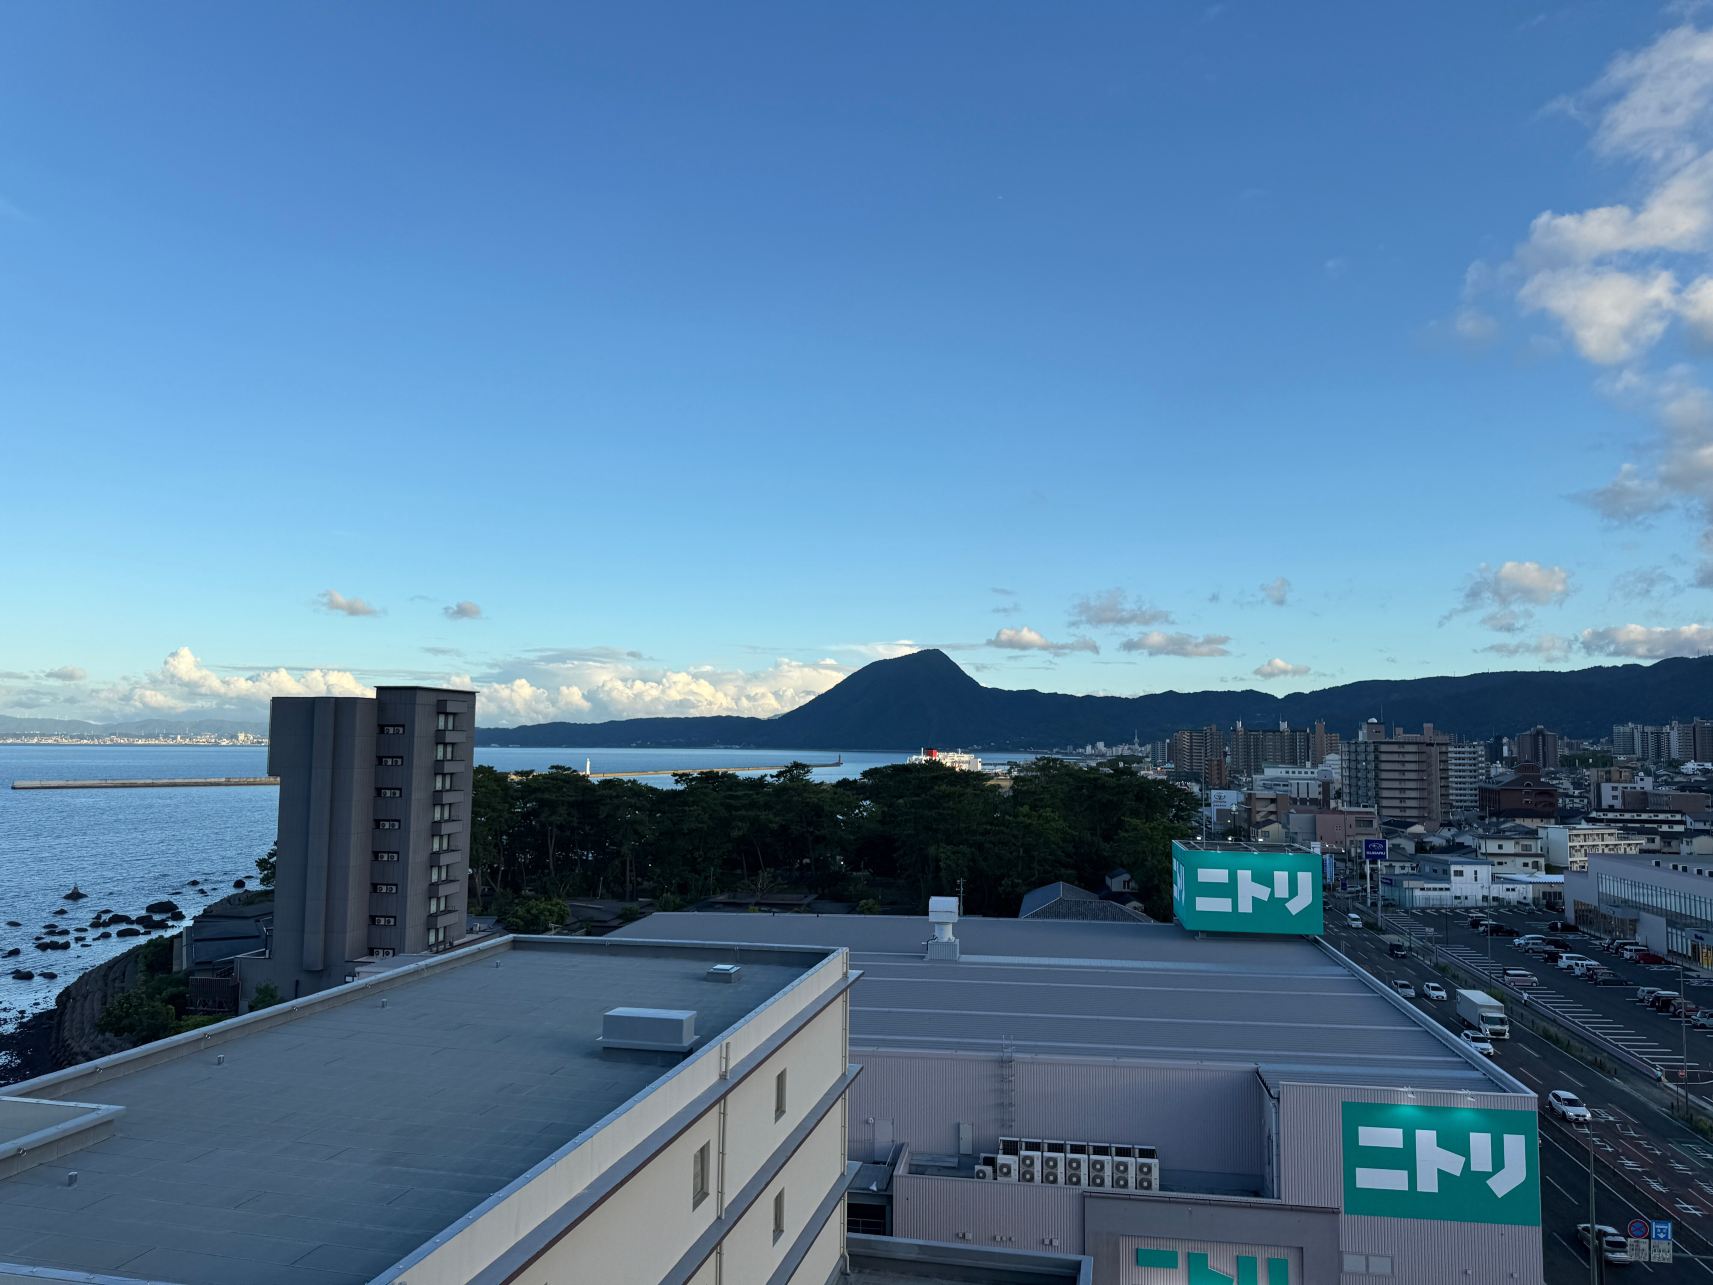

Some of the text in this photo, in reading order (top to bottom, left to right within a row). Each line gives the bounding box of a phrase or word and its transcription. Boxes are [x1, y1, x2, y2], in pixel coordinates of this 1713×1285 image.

[1195, 868, 1313, 916] ニトリ
[1355, 1126, 1526, 1198] ニトリ
